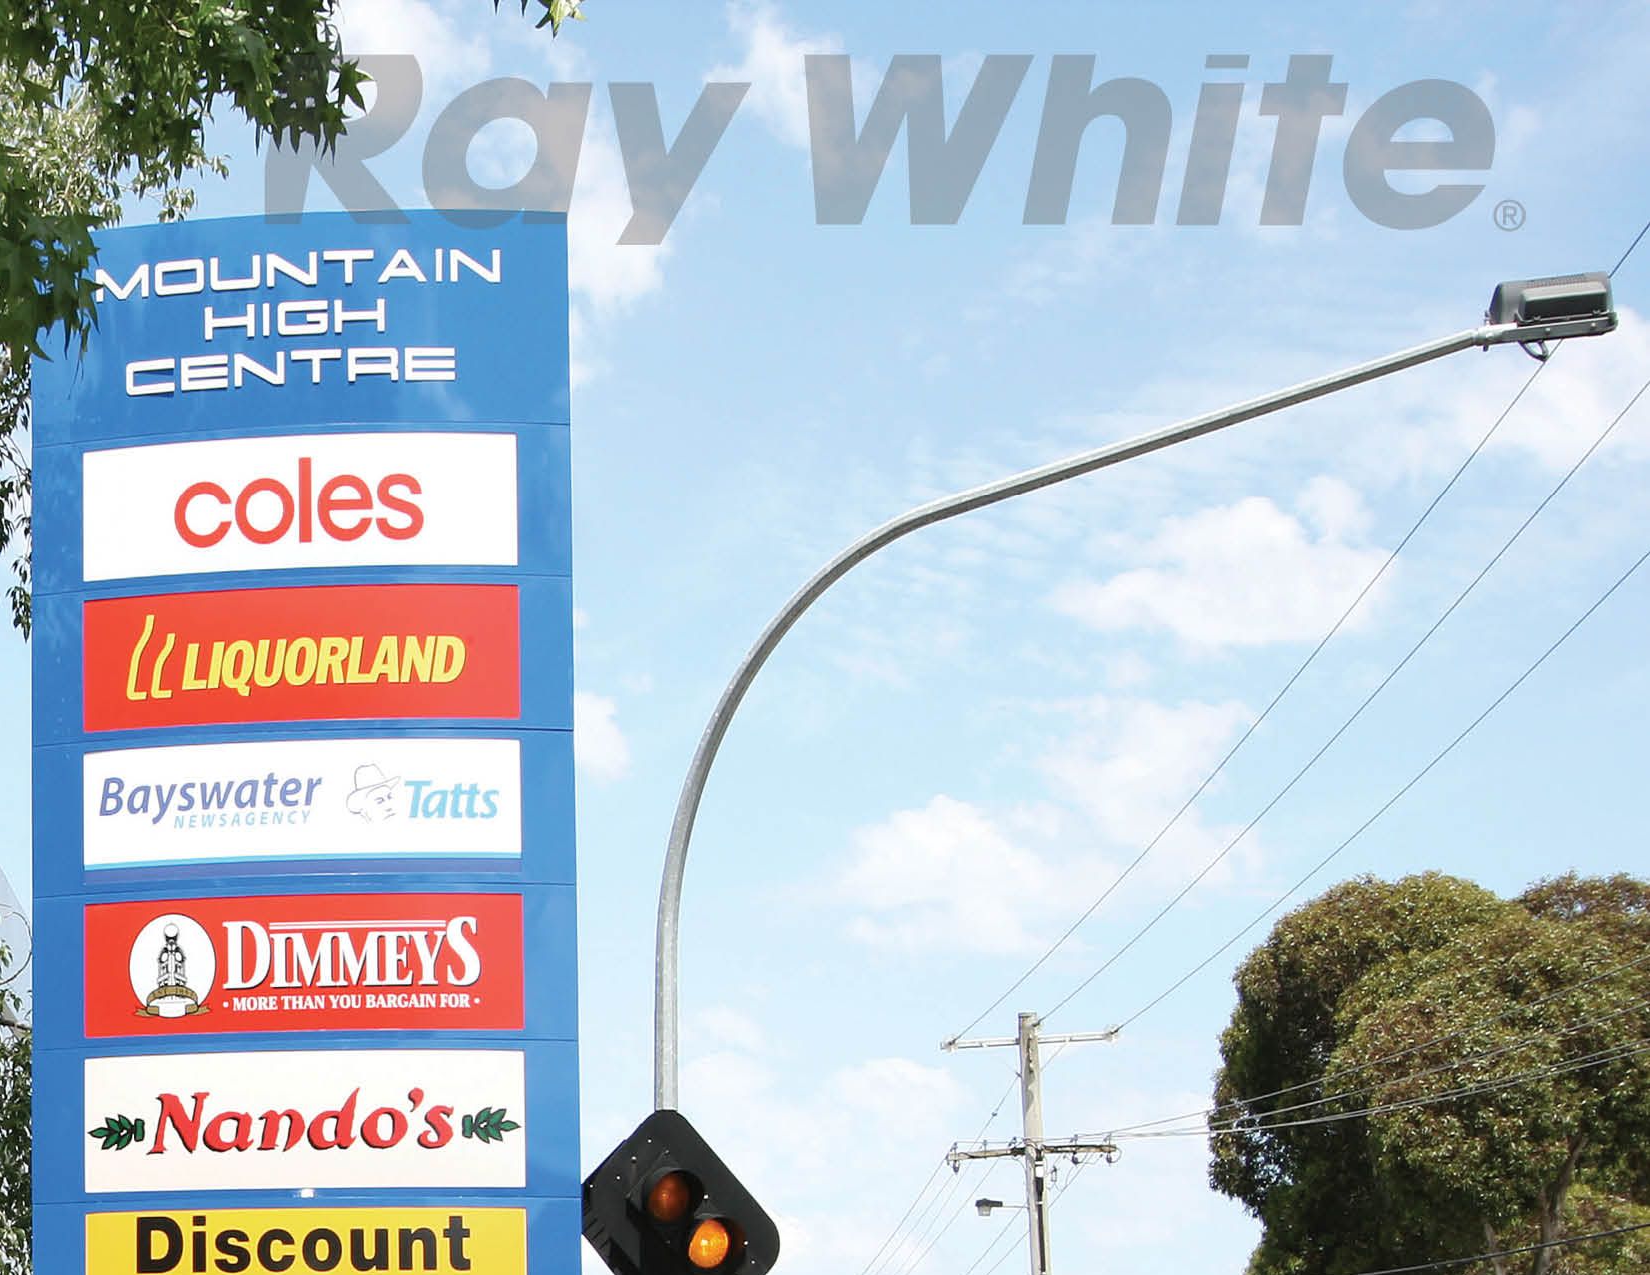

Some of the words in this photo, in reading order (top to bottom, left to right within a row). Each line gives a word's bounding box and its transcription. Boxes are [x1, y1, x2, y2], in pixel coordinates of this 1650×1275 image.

[95, 248, 502, 303] MOUNTAIN
[204, 298, 386, 341] HIGH
[125, 347, 457, 397] CENTRE
[174, 457, 425, 549] coles
[182, 635, 467, 696] LIQUORLAND
[99, 772, 323, 825] Bayswater
[173, 809, 311, 829] NEWSAGENCY
[405, 779, 500, 820] Tatts
[232, 994, 279, 1011] MORE
[281, 994, 325, 1010] THAN
[329, 994, 363, 1010] YOU
[366, 994, 437, 1010] BARGAIN
[439, 994, 470, 1009] FOR
[146, 1087, 455, 1156] Nando's
[136, 1215, 471, 1275] Discount
